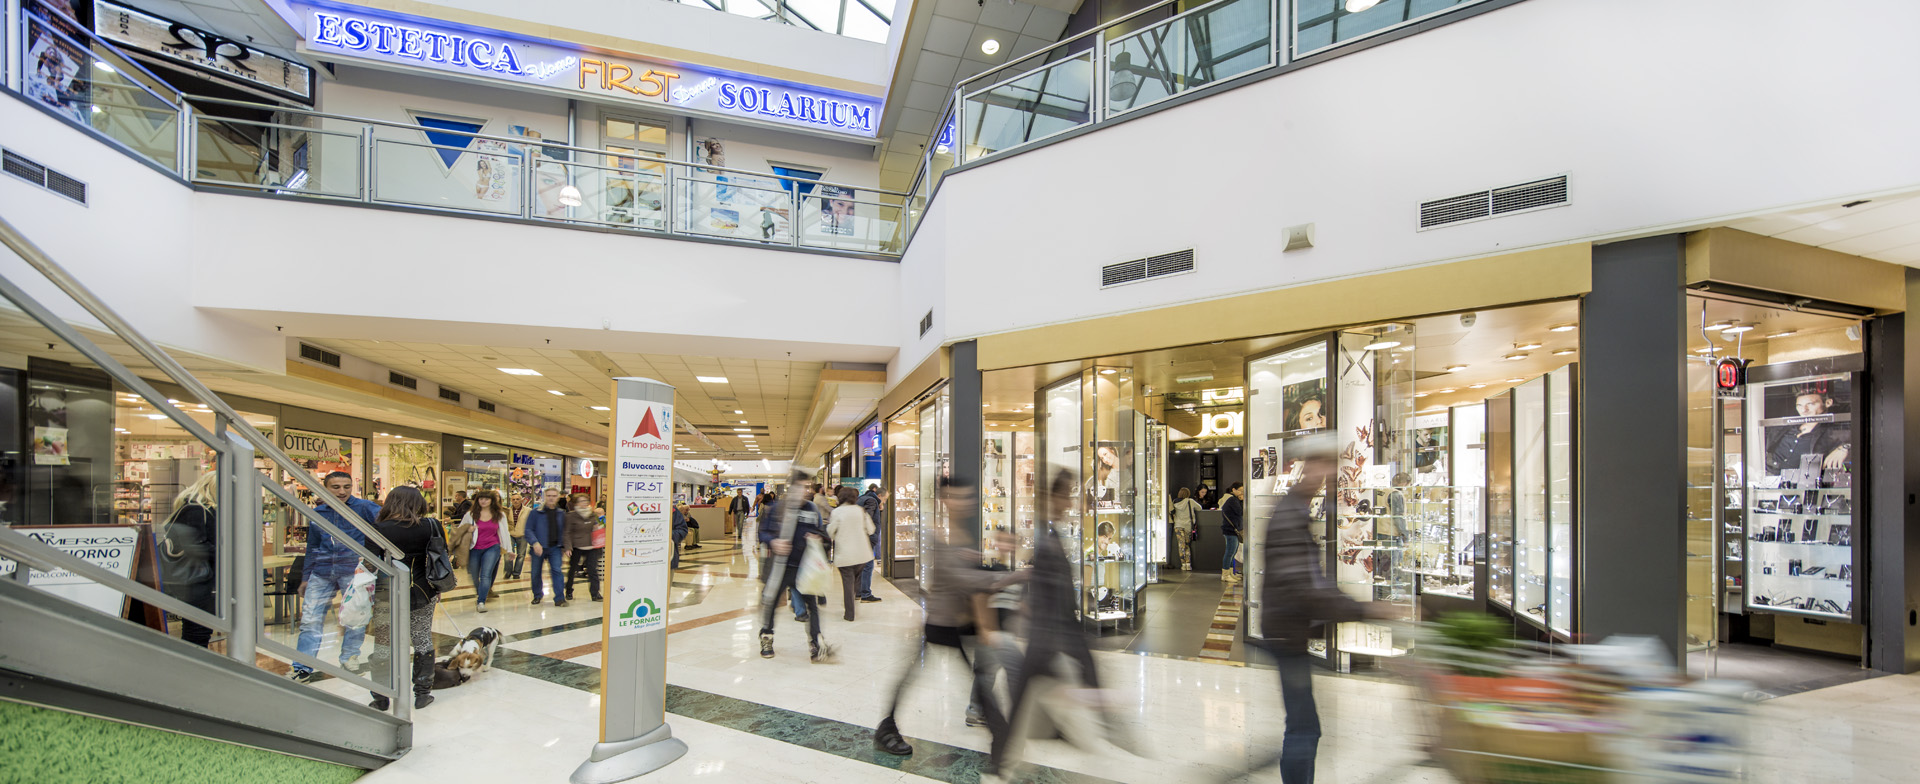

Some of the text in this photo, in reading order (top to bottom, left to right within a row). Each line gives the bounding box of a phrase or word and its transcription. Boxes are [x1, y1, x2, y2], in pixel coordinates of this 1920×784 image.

[313, 12, 525, 76] ESTETICA
[578, 57, 681, 103] FIRST
[717, 80, 875, 131] SOLARIUM
[284, 434, 328, 453] OTTEGA
[621, 439, 670, 451] Primo piano
[317, 448, 339, 460] Casa
[622, 461, 665, 471] Bluvacanze
[626, 481, 664, 493] FIRST
[640, 502, 661, 512] GSI
[62, 548, 121, 560] IORNO
[629, 615, 661, 626] FORNACI
